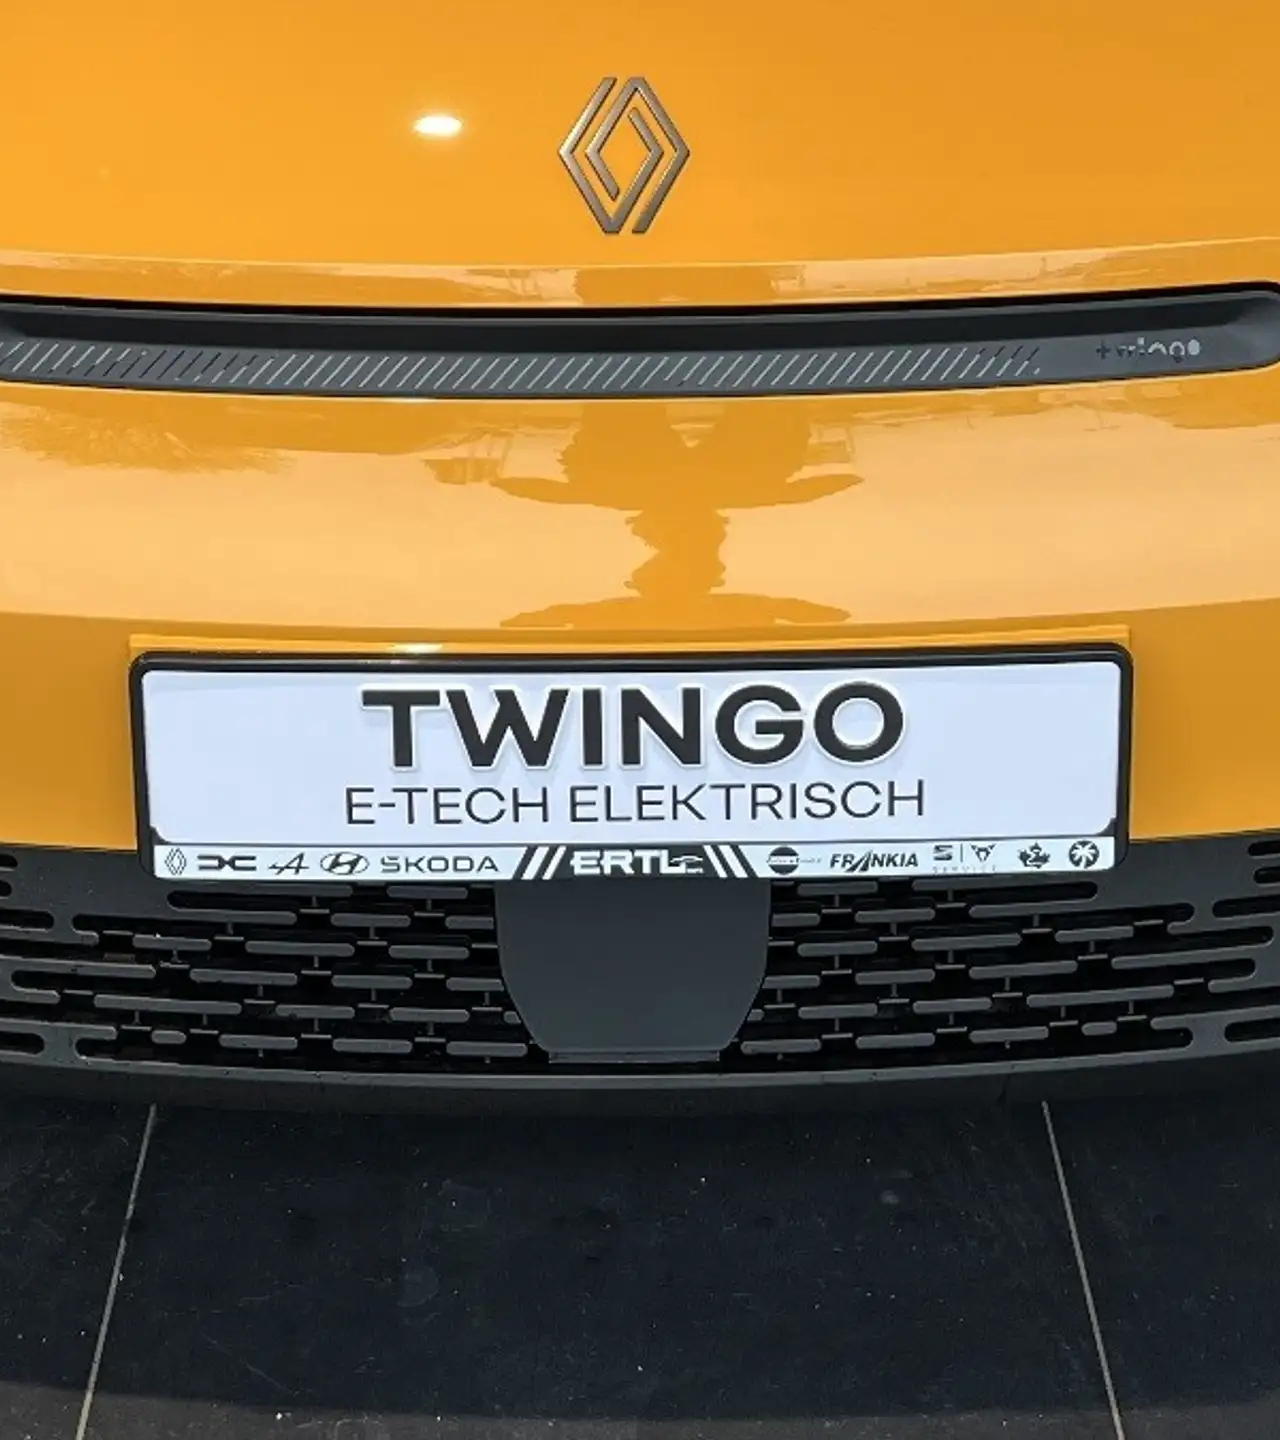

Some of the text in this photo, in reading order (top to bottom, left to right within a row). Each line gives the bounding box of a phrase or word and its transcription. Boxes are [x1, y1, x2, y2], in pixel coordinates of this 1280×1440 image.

[361, 681, 904, 767] TWINGO
[345, 779, 925, 825] E-TECH ELEKTRISCH
[829, 852, 919, 873] FRANKIA
